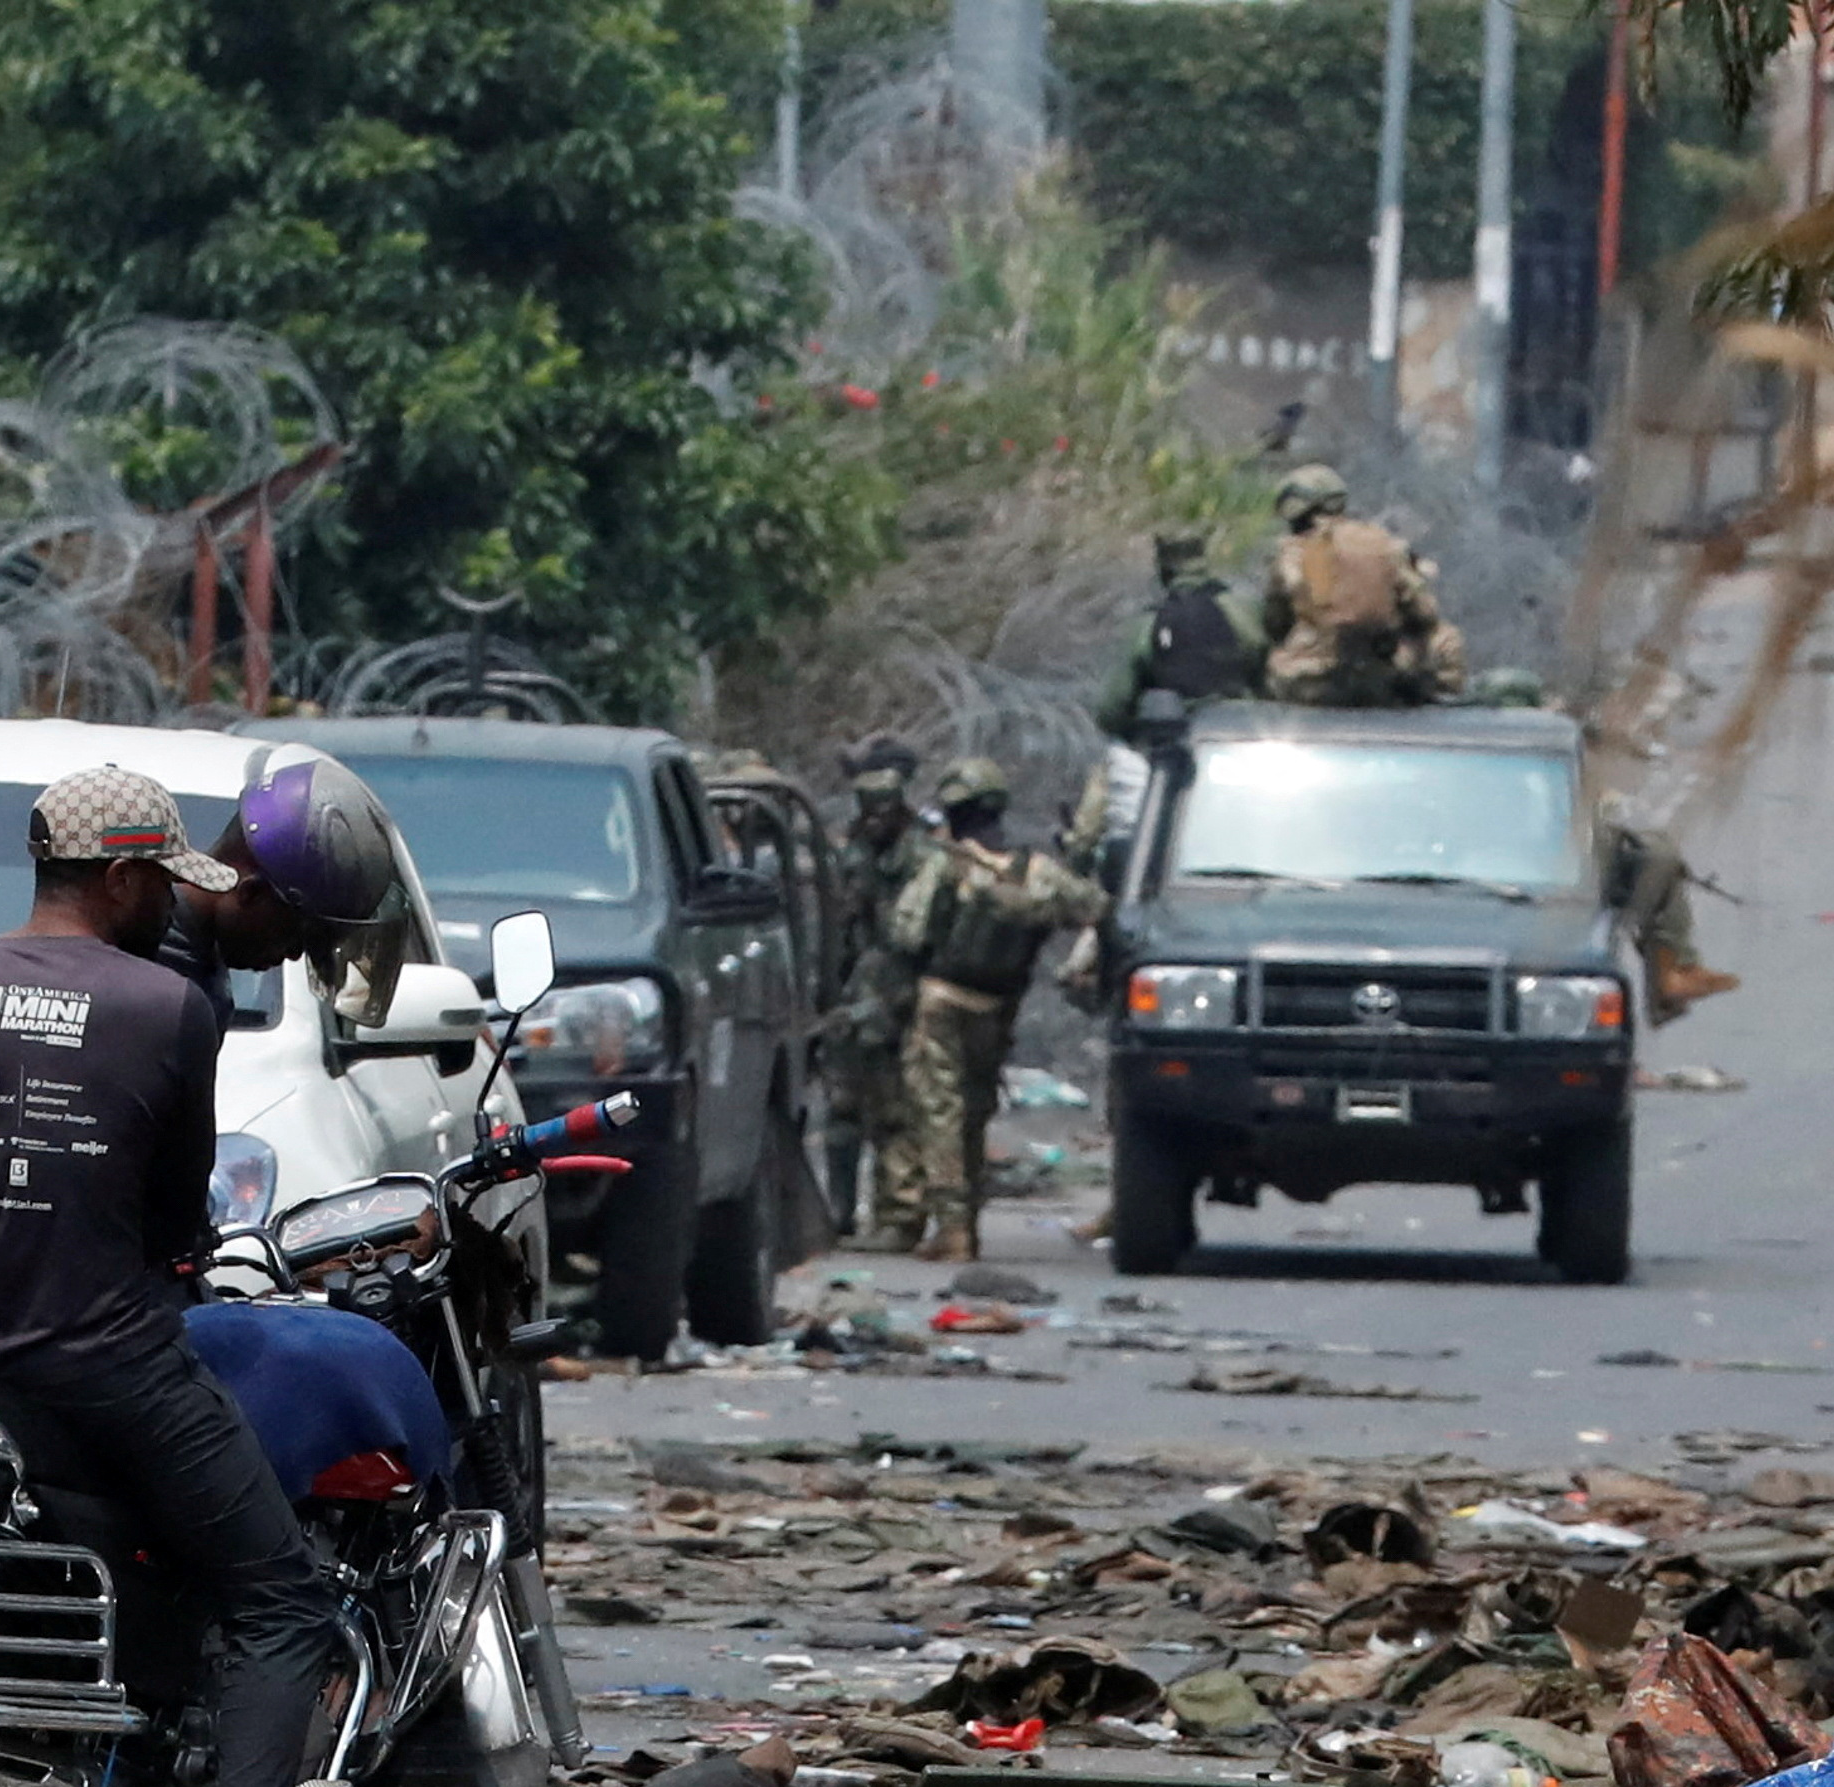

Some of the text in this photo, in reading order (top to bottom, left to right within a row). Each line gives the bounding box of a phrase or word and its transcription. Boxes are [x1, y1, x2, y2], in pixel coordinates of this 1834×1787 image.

[3, 996, 90, 1024] MINI
[0, 1016, 85, 1036] MARATHON
[71, 1141, 109, 1156] meijer
